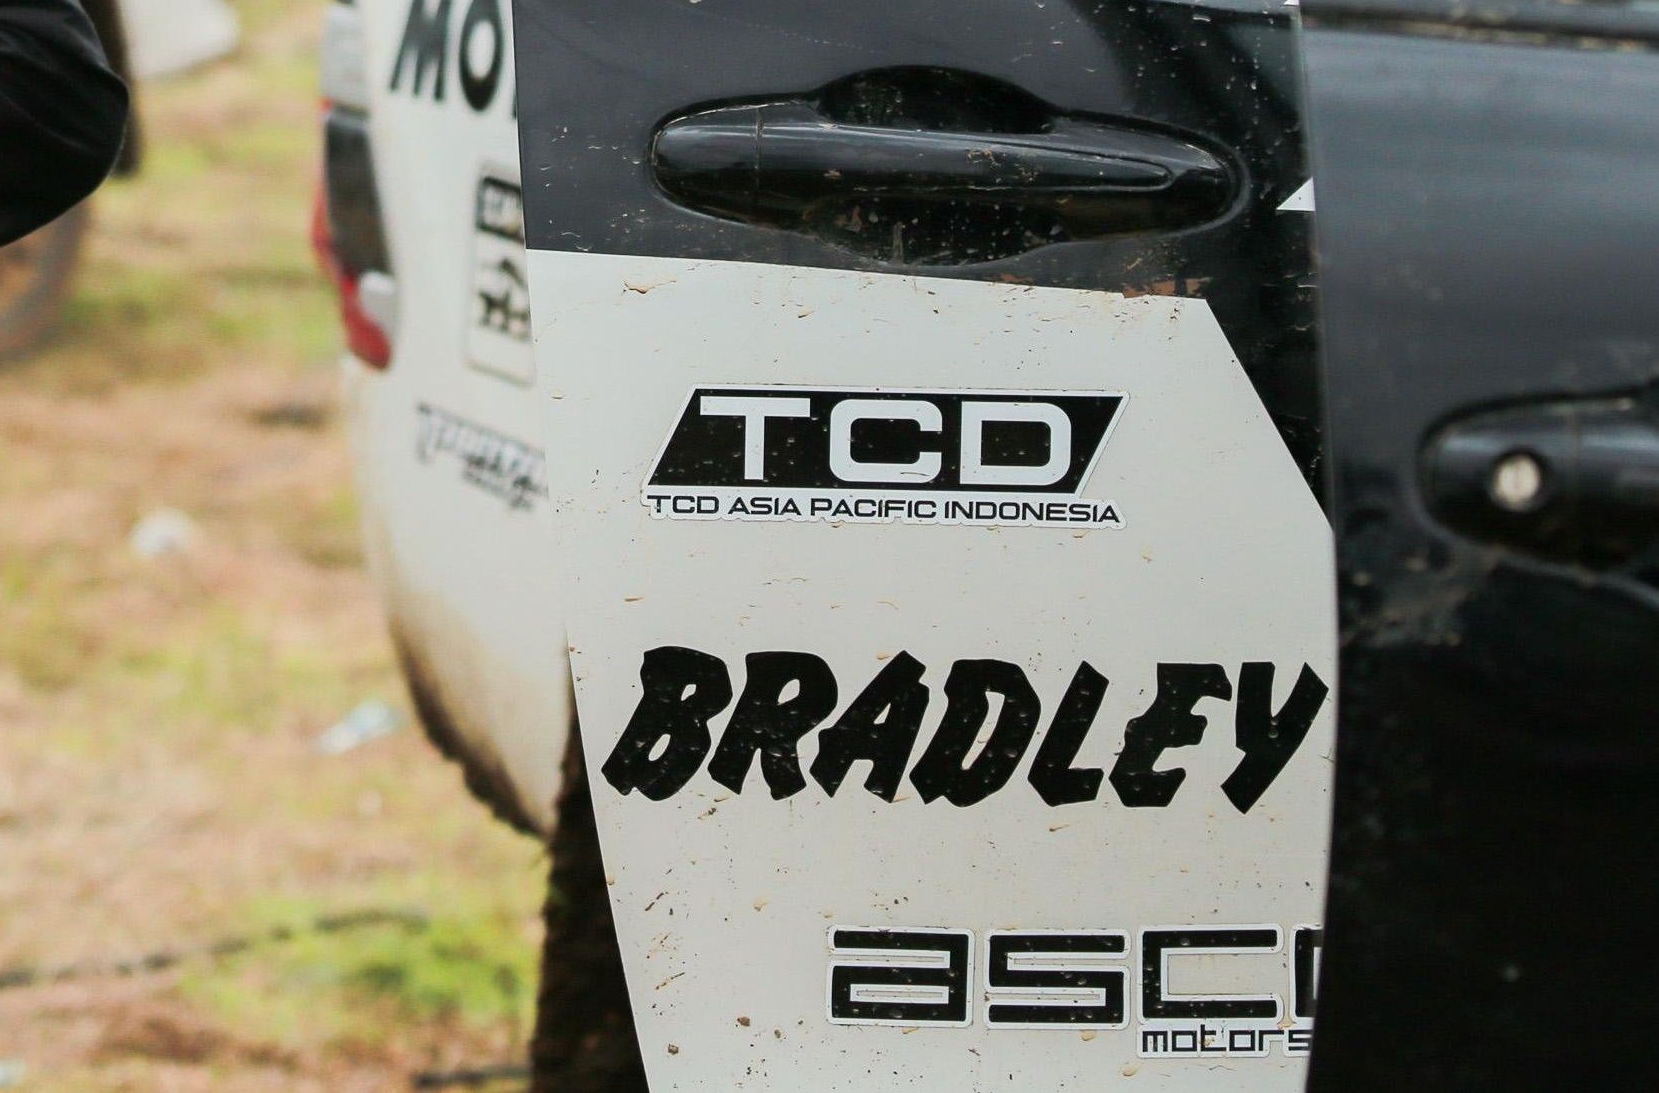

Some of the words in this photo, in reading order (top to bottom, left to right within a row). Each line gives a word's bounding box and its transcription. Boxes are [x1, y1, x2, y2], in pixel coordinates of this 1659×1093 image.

[699, 395, 1072, 487] TCD
[646, 494, 720, 515] TCD
[728, 496, 796, 517] ASIA
[810, 497, 939, 520] PACIFIC
[944, 500, 1121, 524] INDONESIA
[601, 644, 1330, 816] BRADLEY
